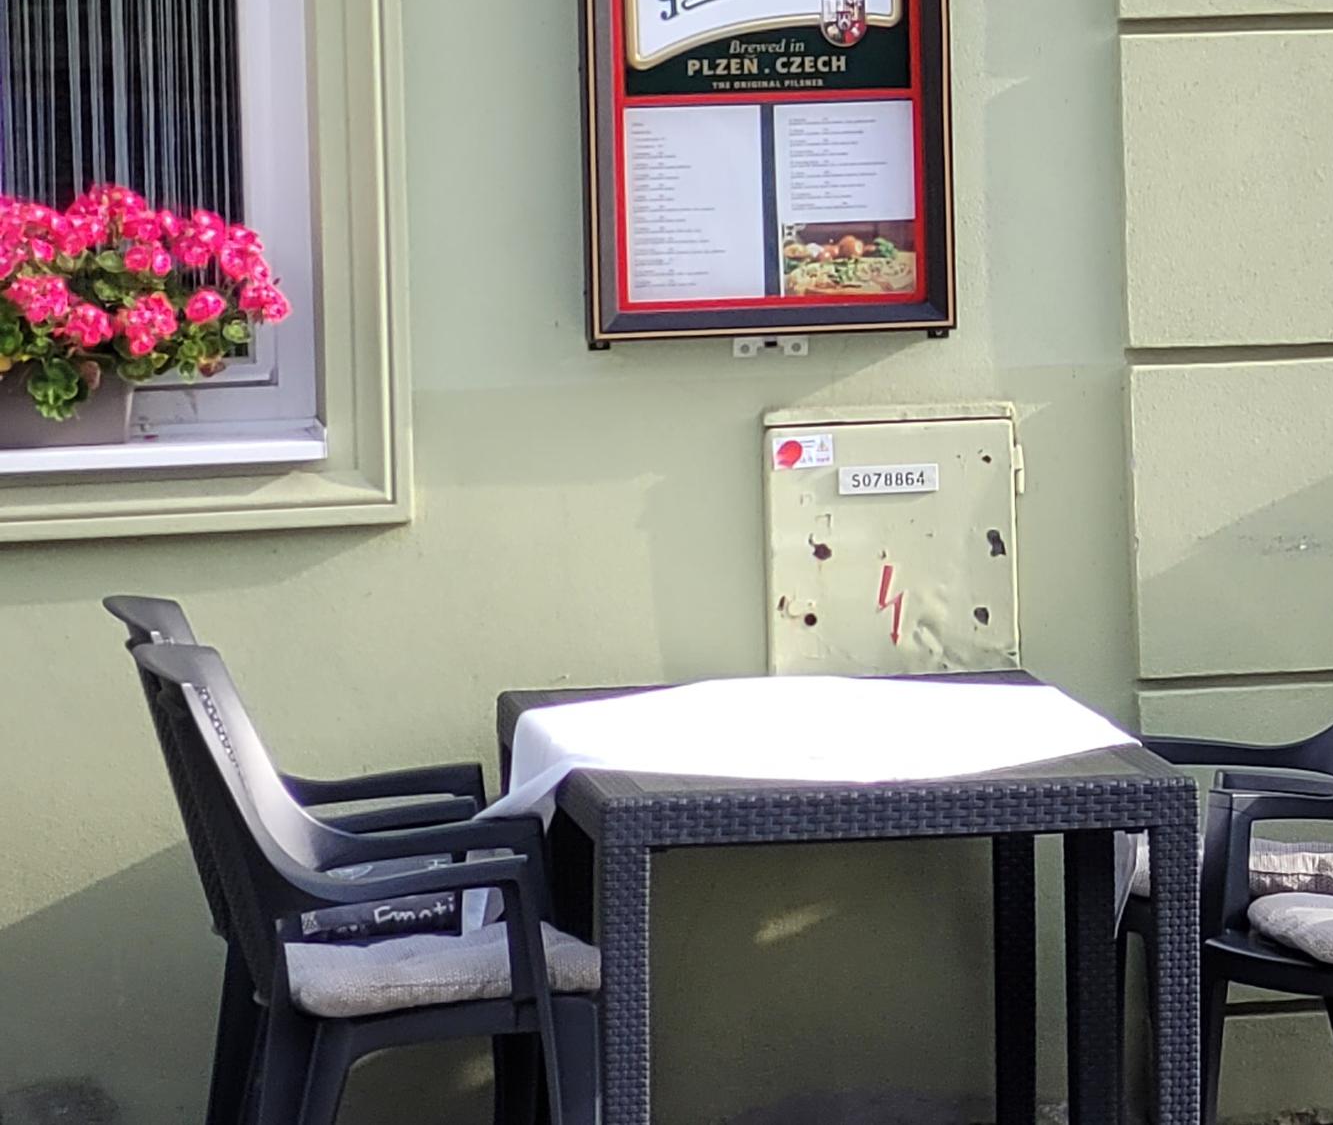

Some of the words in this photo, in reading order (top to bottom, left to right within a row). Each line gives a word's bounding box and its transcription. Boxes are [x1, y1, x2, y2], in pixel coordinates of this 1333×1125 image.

[729, 39, 786, 54] Brewed
[789, 38, 805, 53] in
[775, 56, 847, 74] CZECH
[712, 81, 731, 90] THE
[734, 80, 781, 89] ORIGINAL
[784, 78, 824, 88] PILSNER
